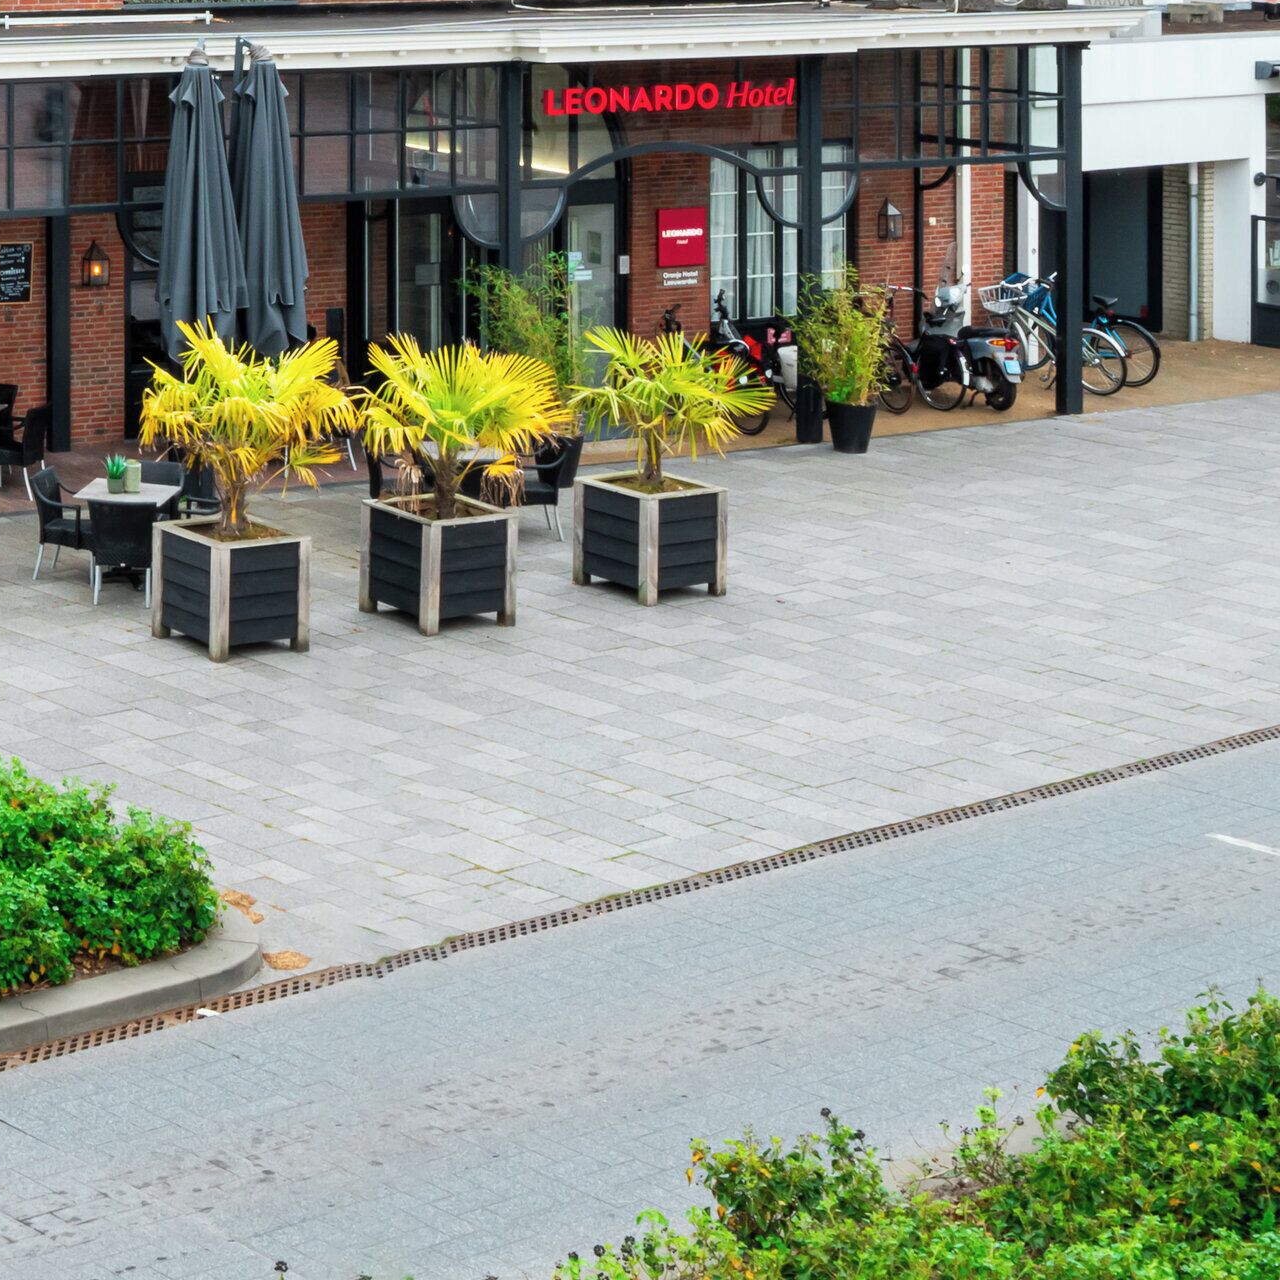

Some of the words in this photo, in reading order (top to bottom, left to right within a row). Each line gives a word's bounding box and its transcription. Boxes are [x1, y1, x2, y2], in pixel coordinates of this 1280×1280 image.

[543, 82, 719, 117] LEONARDO
[726, 78, 796, 108] Hotel
[662, 228, 703, 238] LEONARDO
